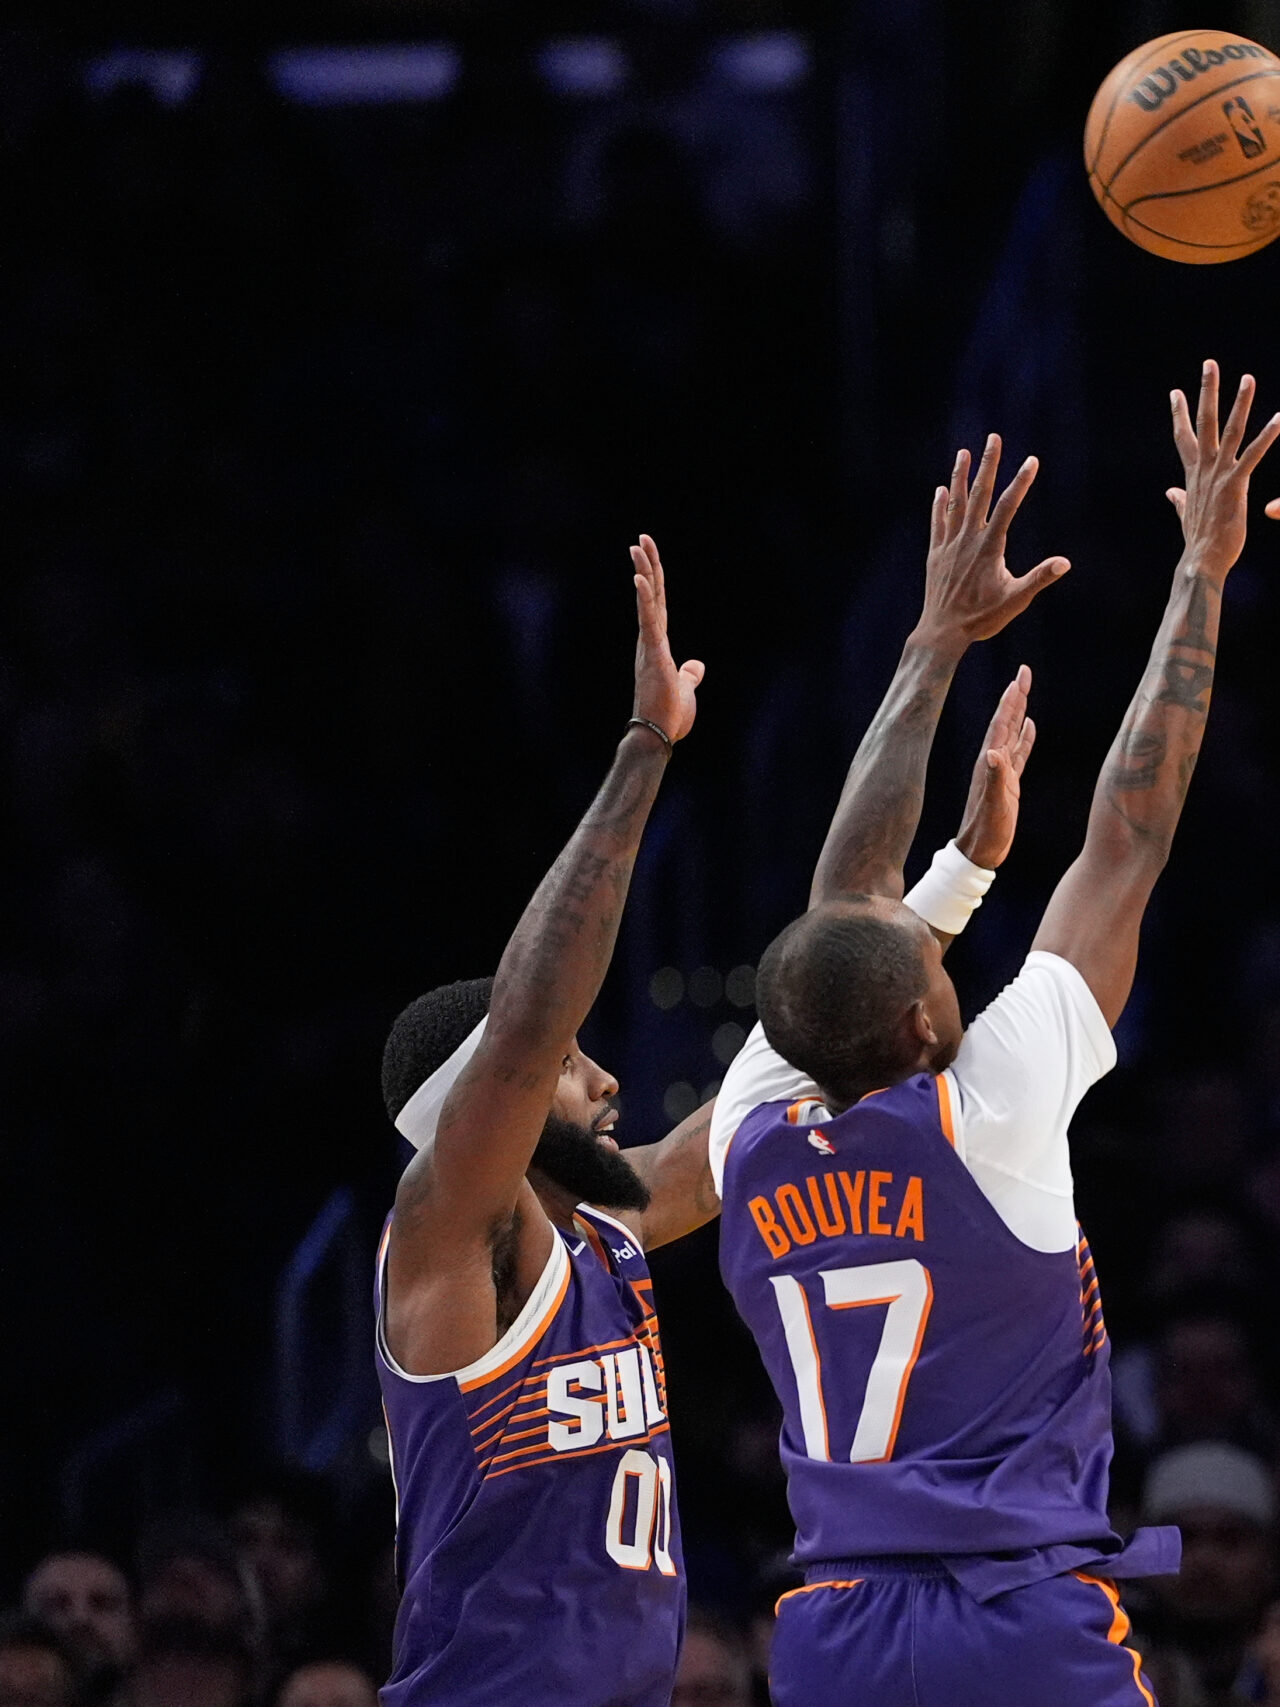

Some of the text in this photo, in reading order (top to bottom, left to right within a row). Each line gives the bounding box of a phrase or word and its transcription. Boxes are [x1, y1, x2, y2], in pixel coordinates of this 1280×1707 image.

[1131, 44, 1269, 112] Wilson
[748, 1170, 924, 1259] BOUYEA
[768, 1258, 933, 1463] 17
